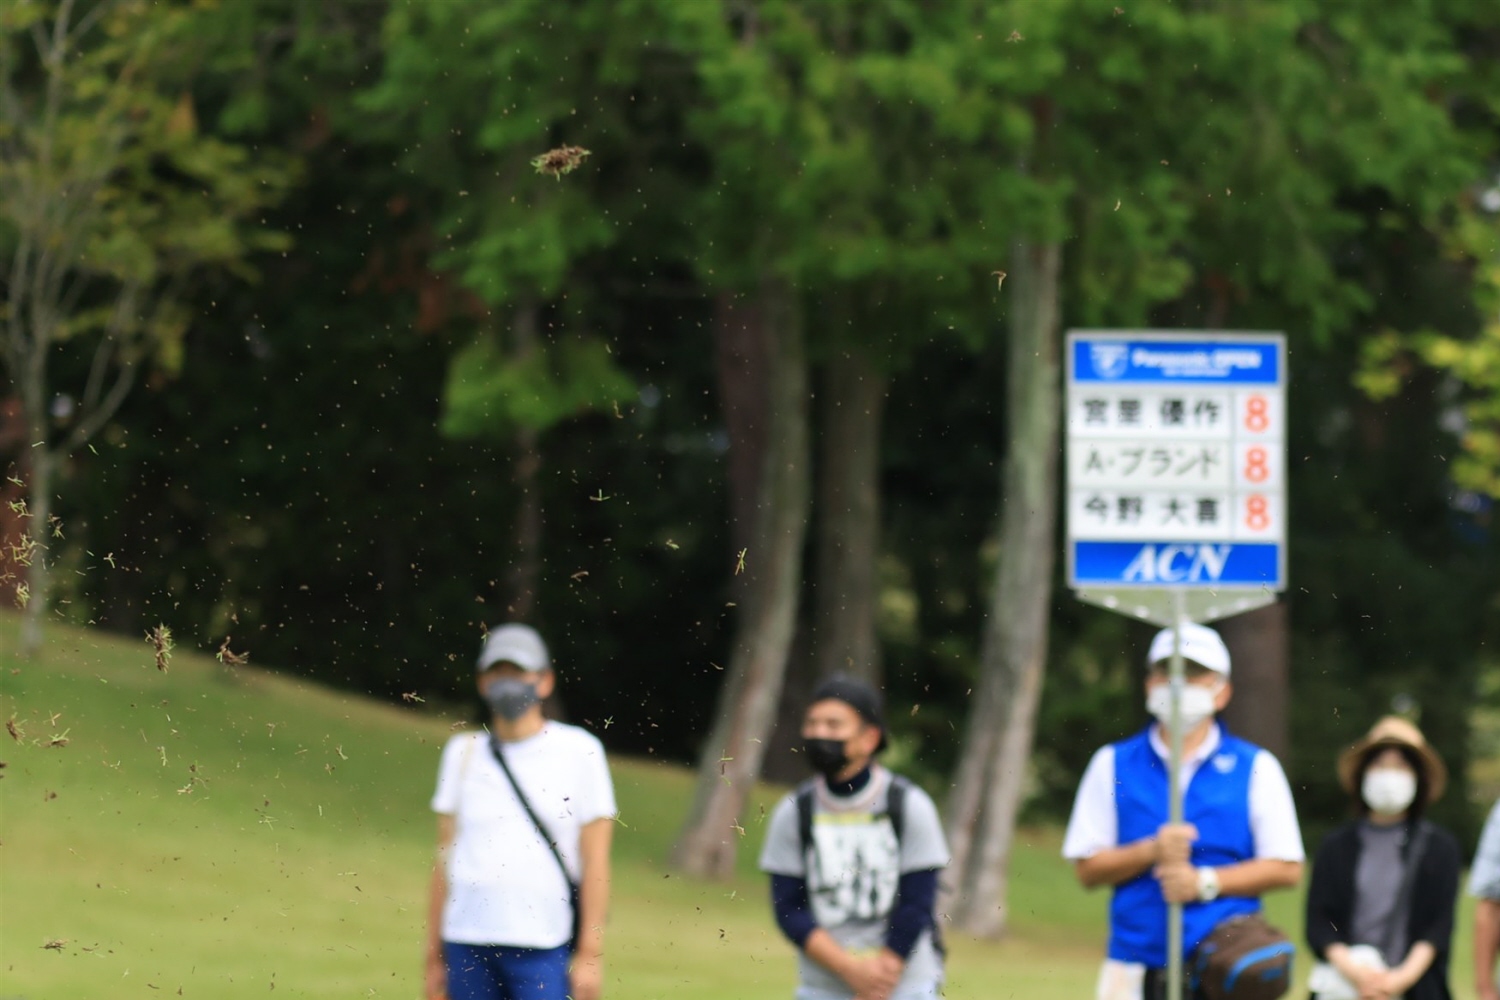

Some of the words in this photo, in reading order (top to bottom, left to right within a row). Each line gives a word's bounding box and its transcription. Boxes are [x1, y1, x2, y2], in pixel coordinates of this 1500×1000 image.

[1244, 394, 1270, 432] 8
[1244, 446, 1270, 483] 8
[1244, 493, 1270, 531] 8
[1123, 544, 1233, 581] ACN
